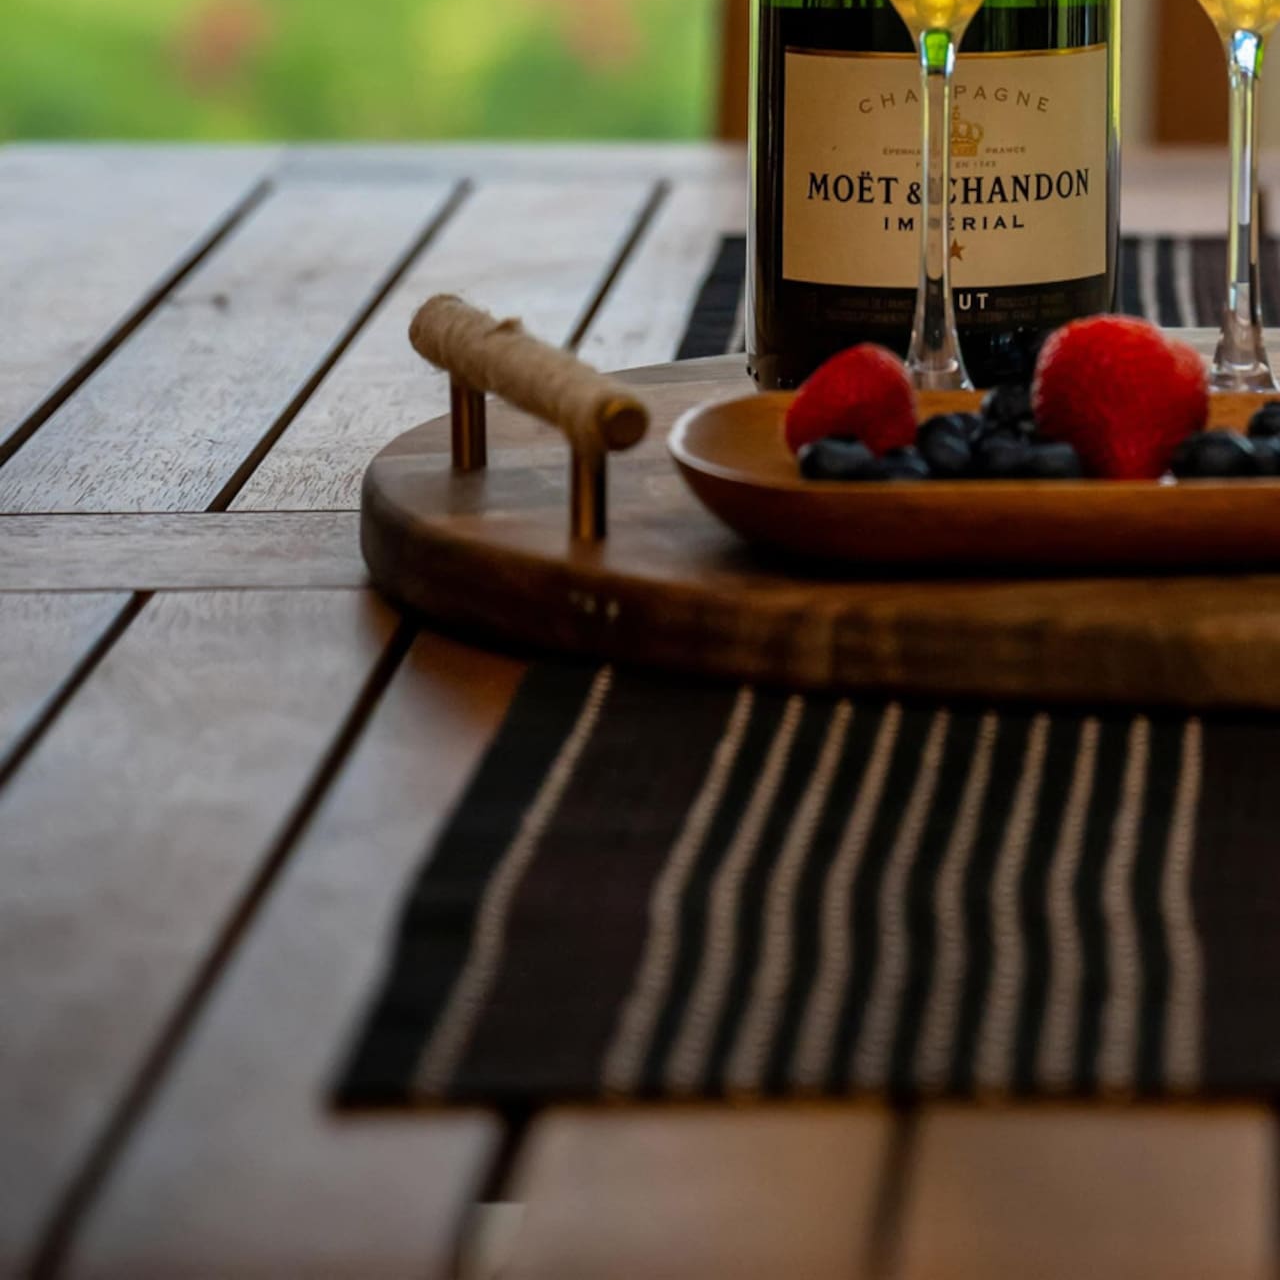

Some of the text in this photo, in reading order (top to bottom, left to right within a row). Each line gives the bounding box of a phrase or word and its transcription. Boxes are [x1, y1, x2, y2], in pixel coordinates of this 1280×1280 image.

[858, 84, 1050, 114] CHAPAGNE
[882, 145, 922, 156] ÉPERNA
[807, 171, 898, 205] MOËT
[906, 181, 922, 205] &
[883, 212, 1025, 231] IMÉRIAL
[958, 292, 989, 310] UT
